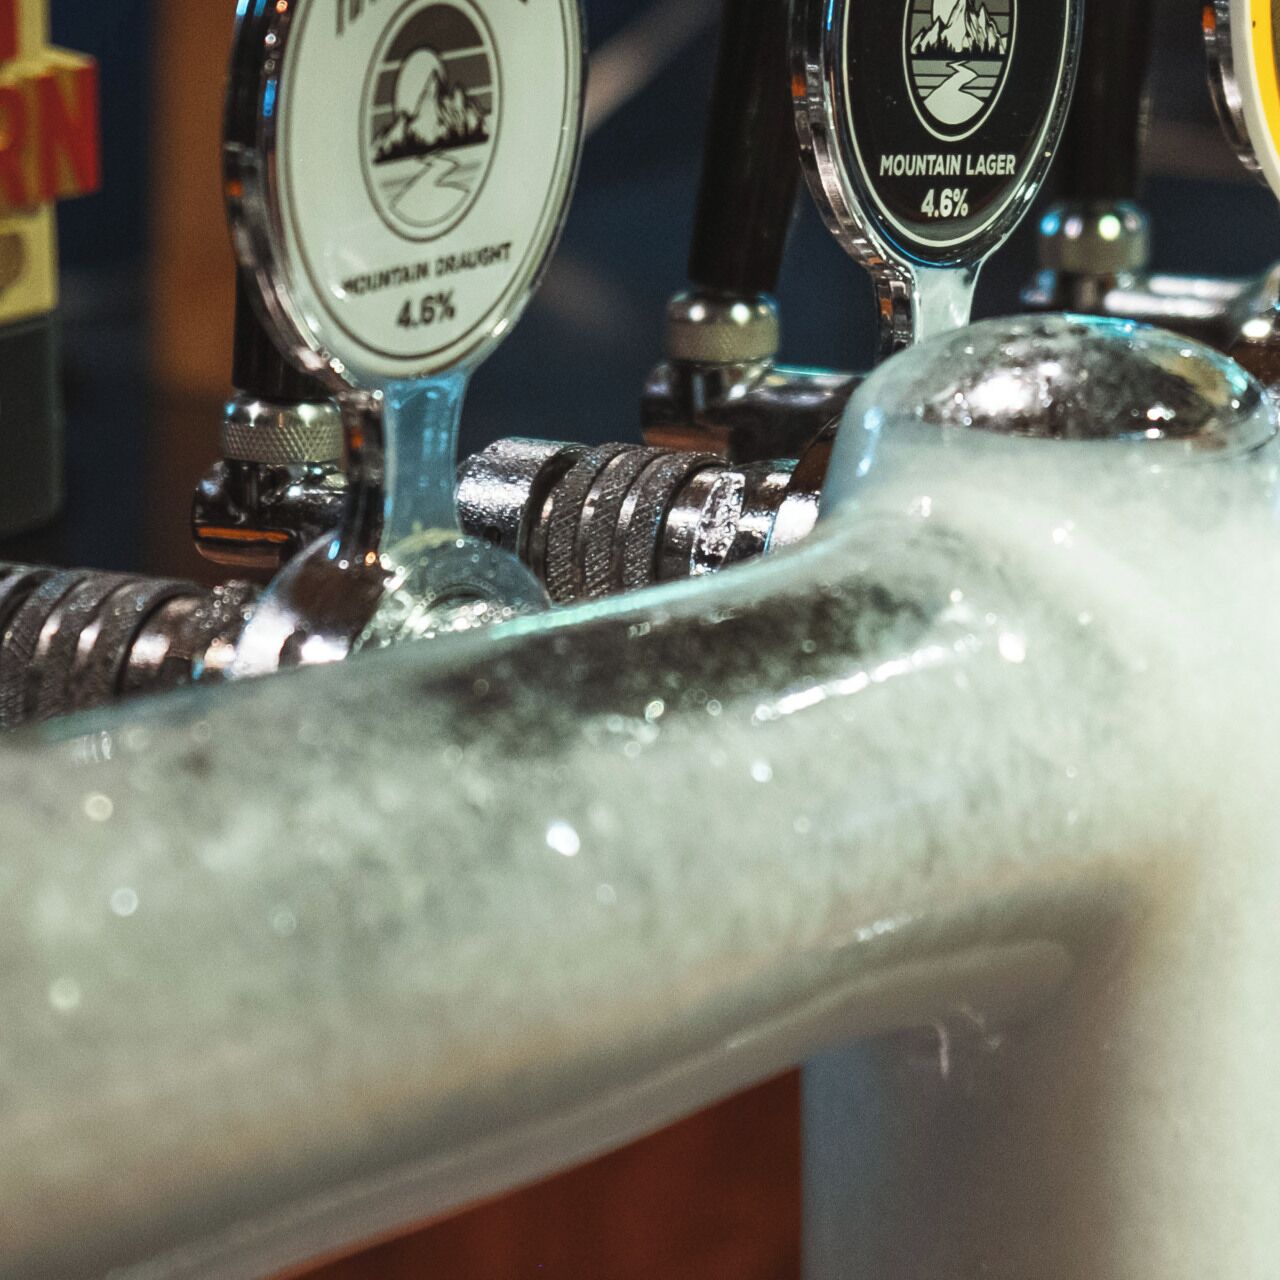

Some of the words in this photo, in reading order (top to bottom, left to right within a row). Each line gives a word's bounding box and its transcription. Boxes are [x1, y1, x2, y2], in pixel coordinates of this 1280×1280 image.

[879, 154, 962, 177] MOUNTAIN
[965, 154, 1016, 175] LAGER
[921, 188, 969, 218] 4.6%
[341, 261, 429, 295] MOUNTAIN
[434, 241, 512, 277] DRAUGHT
[395, 289, 456, 329] 4.6%
